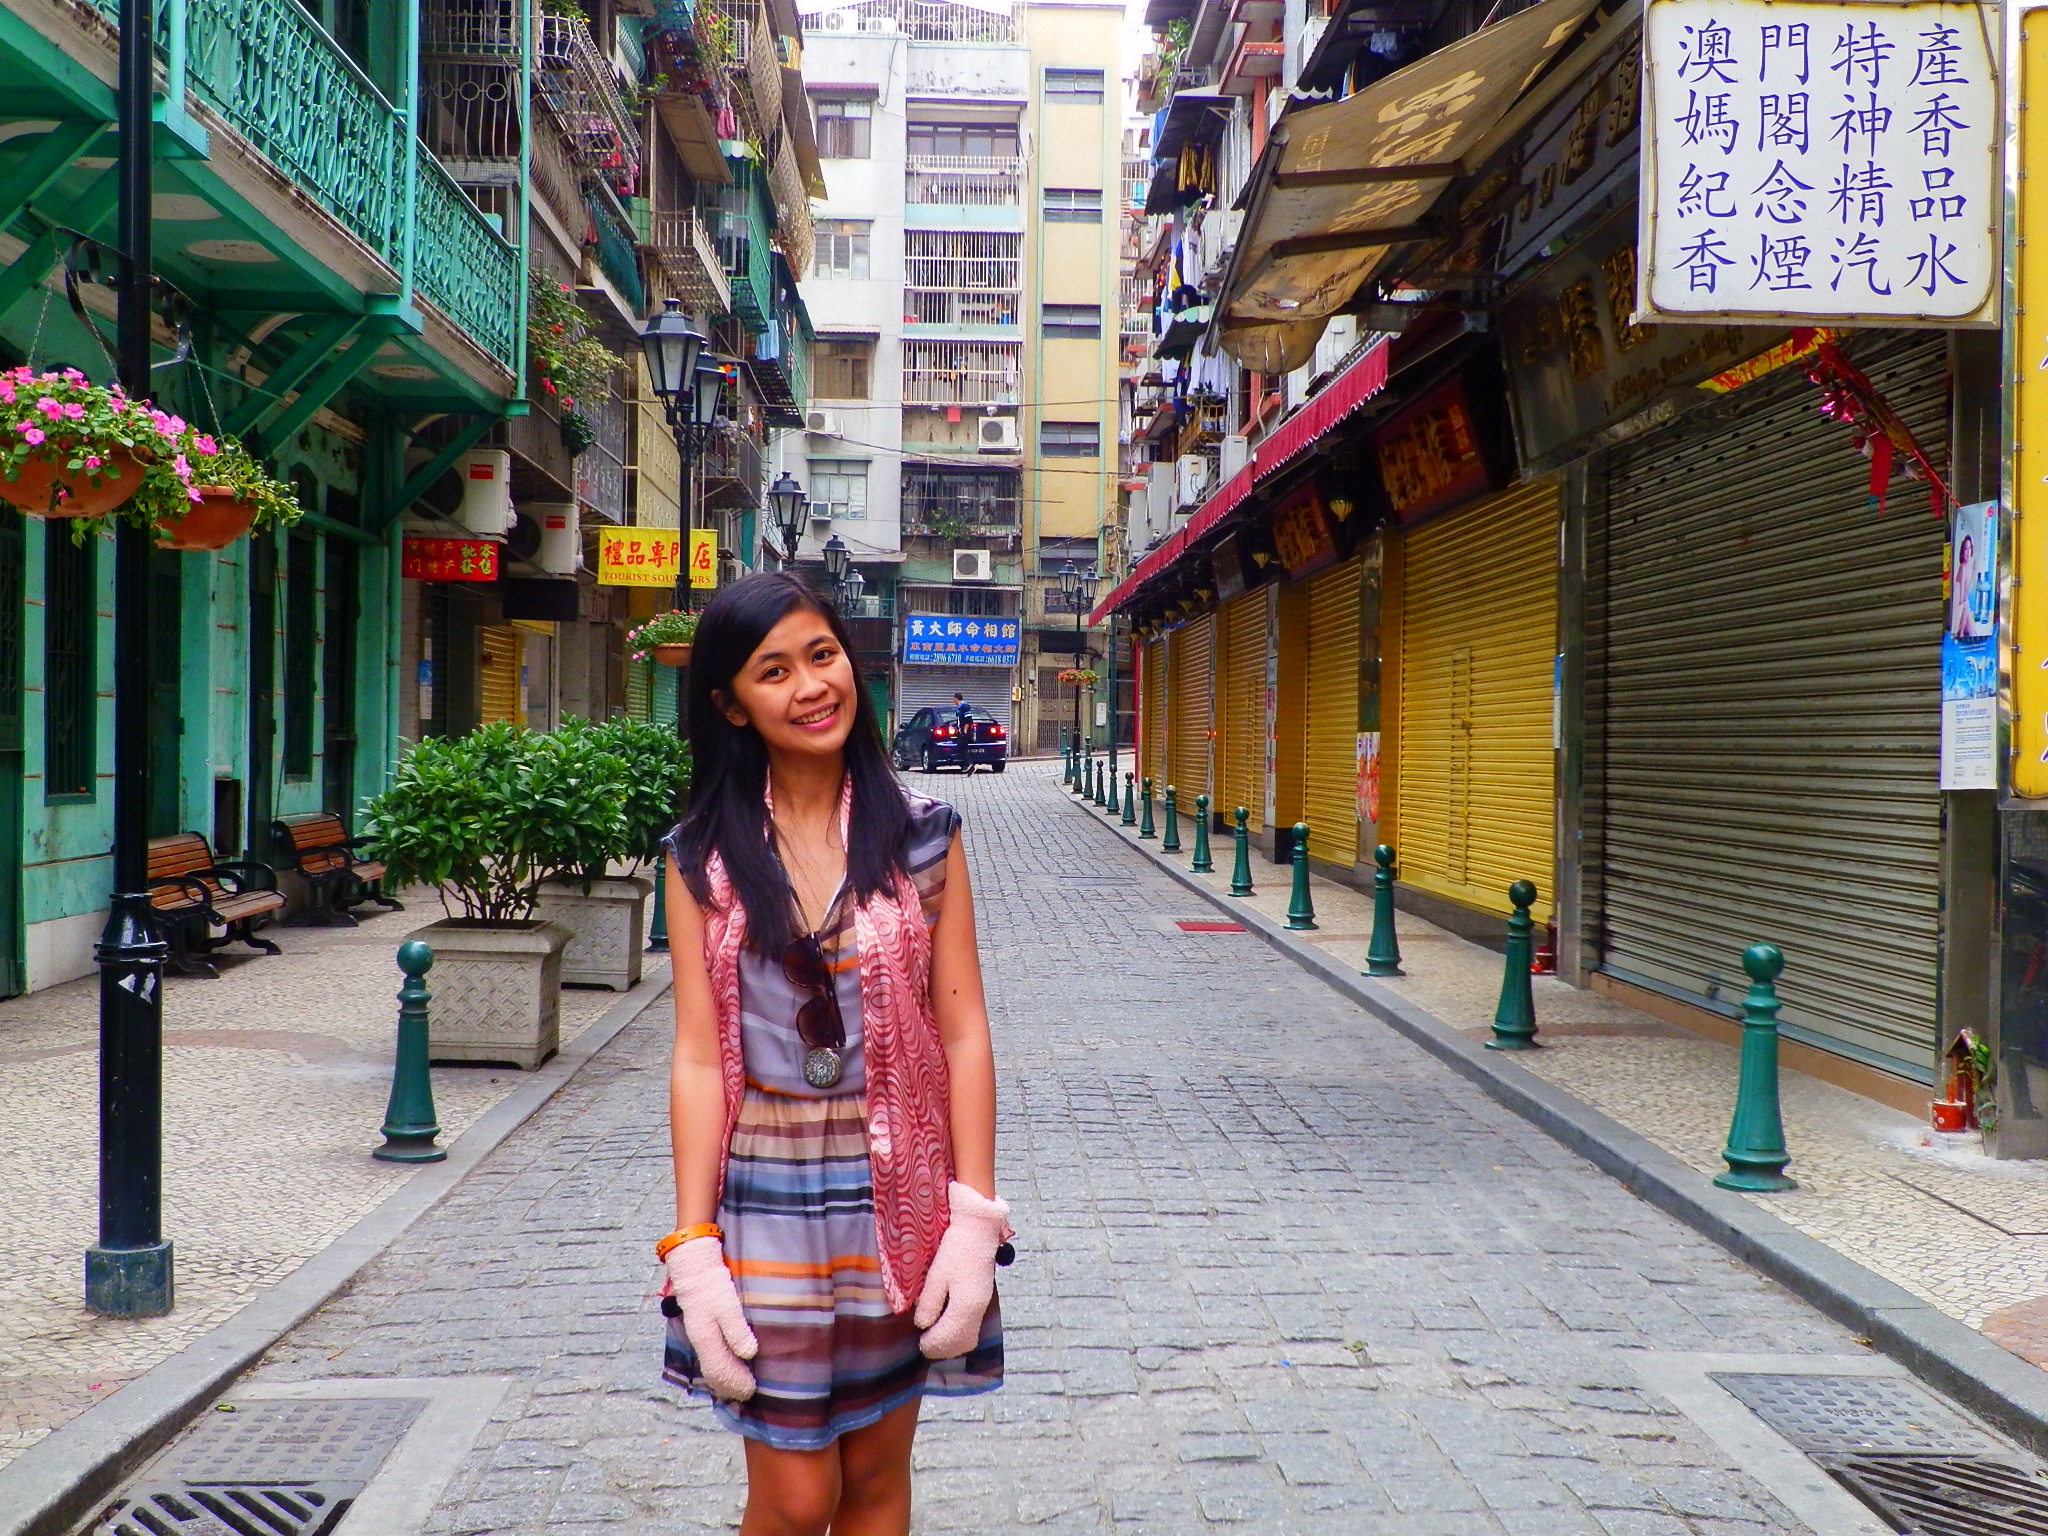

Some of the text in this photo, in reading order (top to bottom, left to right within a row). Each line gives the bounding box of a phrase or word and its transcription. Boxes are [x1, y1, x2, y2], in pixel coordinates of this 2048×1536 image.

[1676, 18, 1970, 88] 澳門特產
[1673, 89, 1971, 158] 媽閣神香
[1675, 158, 1967, 228] 紀念精品
[1672, 228, 1969, 297] 香煙汽水
[603, 571, 711, 584] TOURIST SOUIRS
[911, 619, 1017, 638] 黃大師命相館
